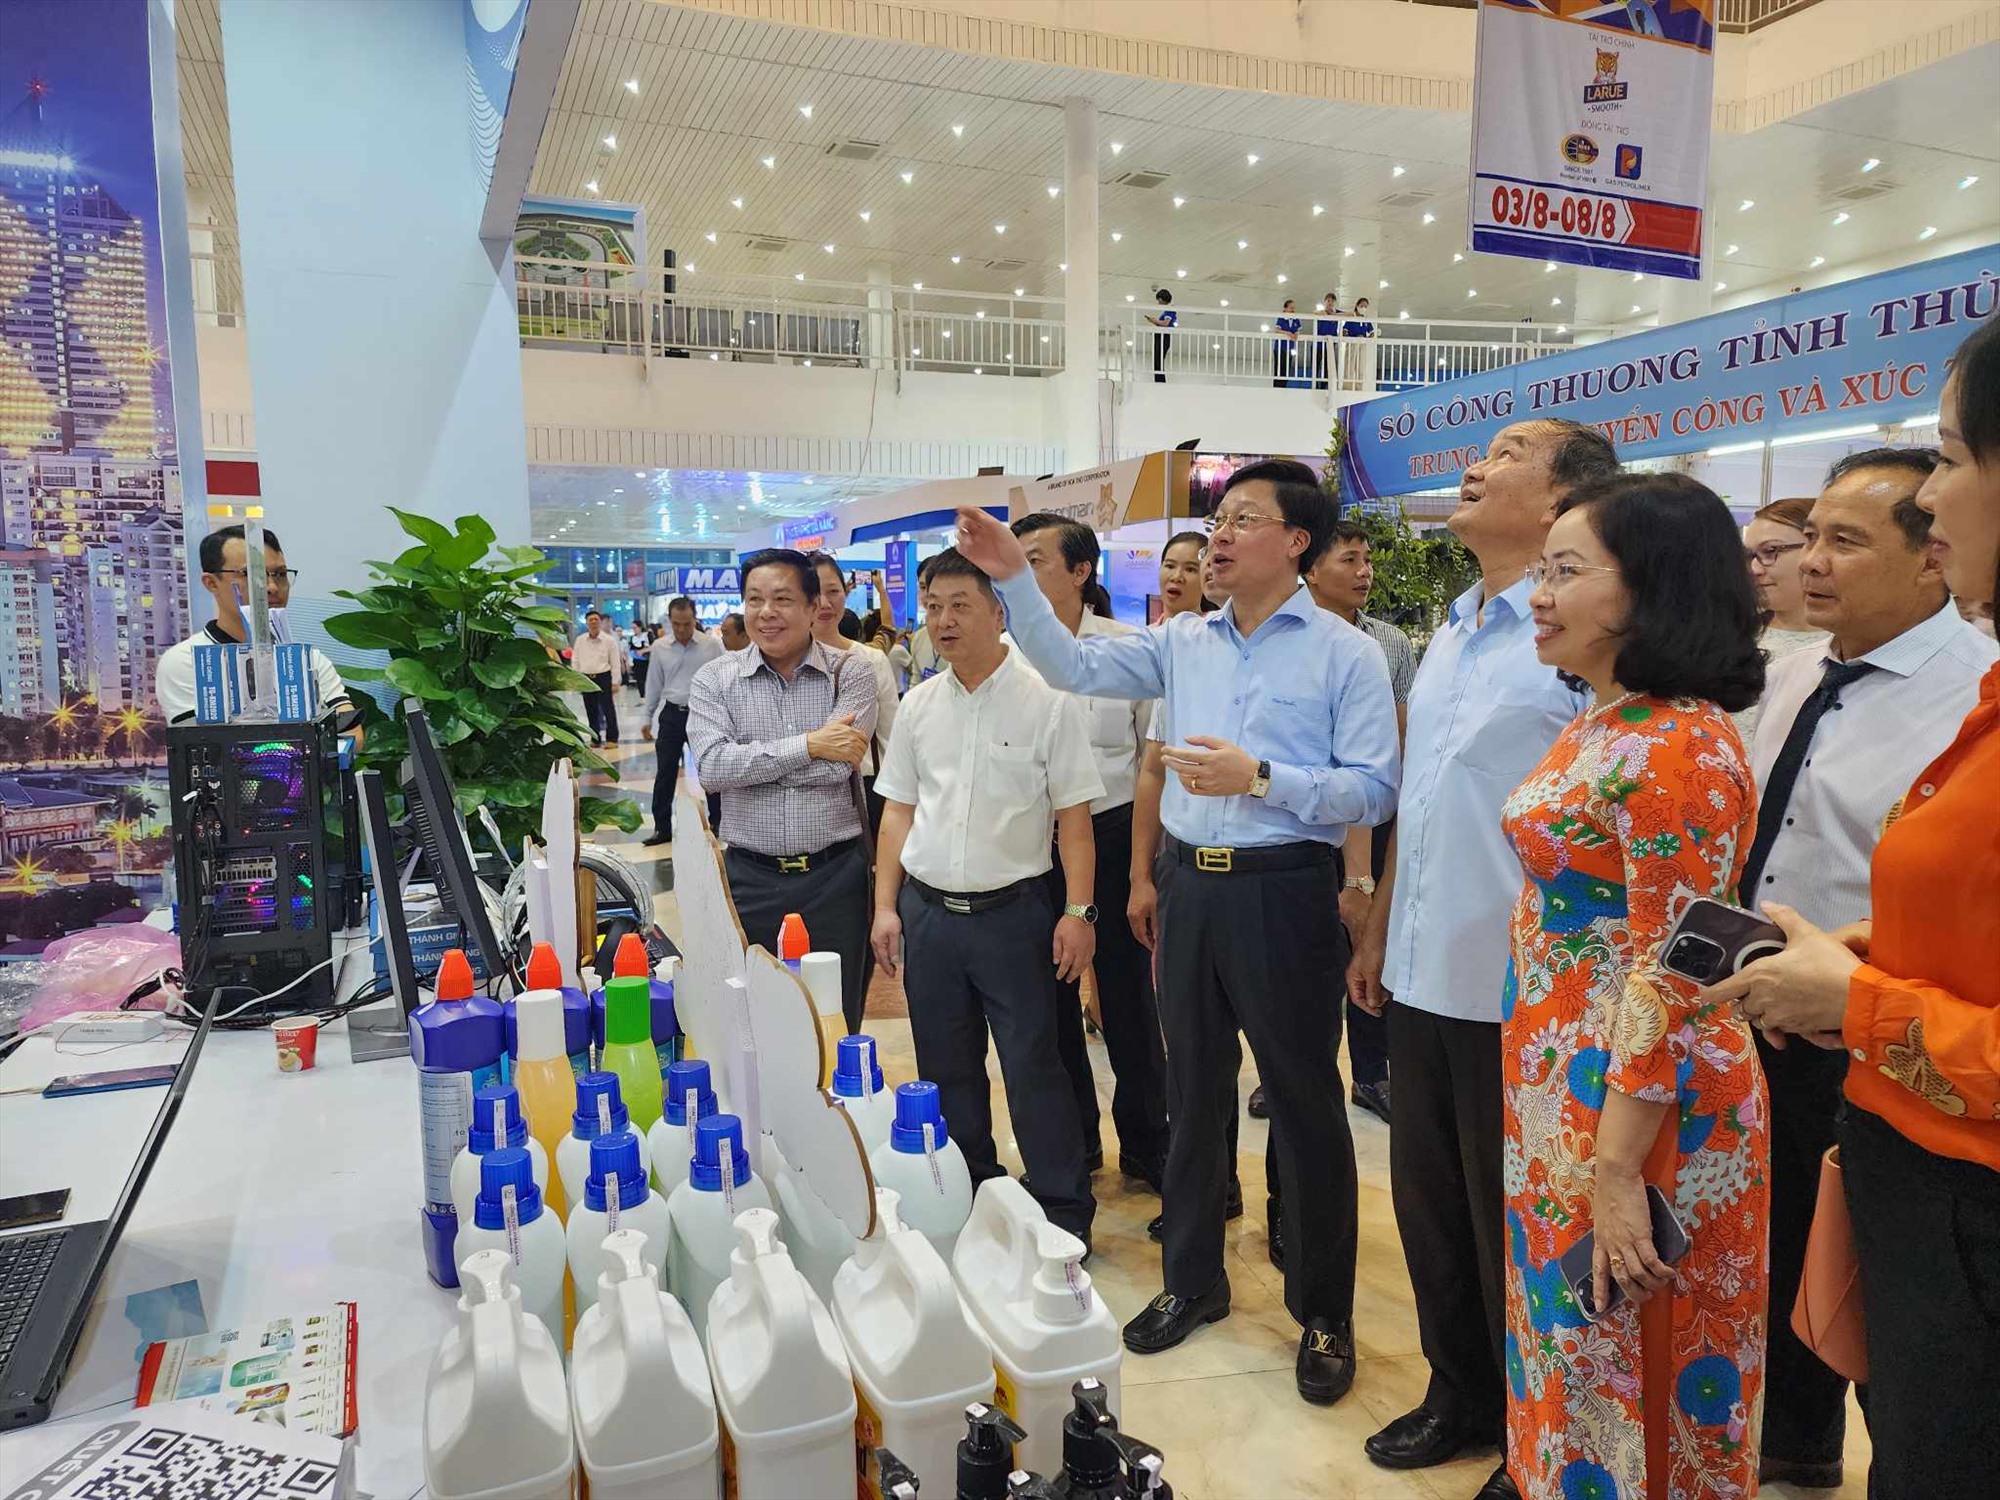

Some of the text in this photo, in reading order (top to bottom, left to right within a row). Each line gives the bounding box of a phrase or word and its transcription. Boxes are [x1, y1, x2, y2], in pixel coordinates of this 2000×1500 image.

[1587, 84, 1624, 101] LARUE
[1591, 102, 1619, 114] SMOOTH
[1491, 185, 1617, 240] 03/8-08/8
[1425, 389, 1515, 432] CÔNG
[1717, 309, 1850, 371] TỈNH
[1409, 445, 1481, 478] TRUNG
[1672, 393, 1764, 437] CÔNG
[1777, 376, 1829, 418] VÀ
[1838, 360, 1927, 409] XÚC
[40, 1428, 121, 1486] QUÉT
